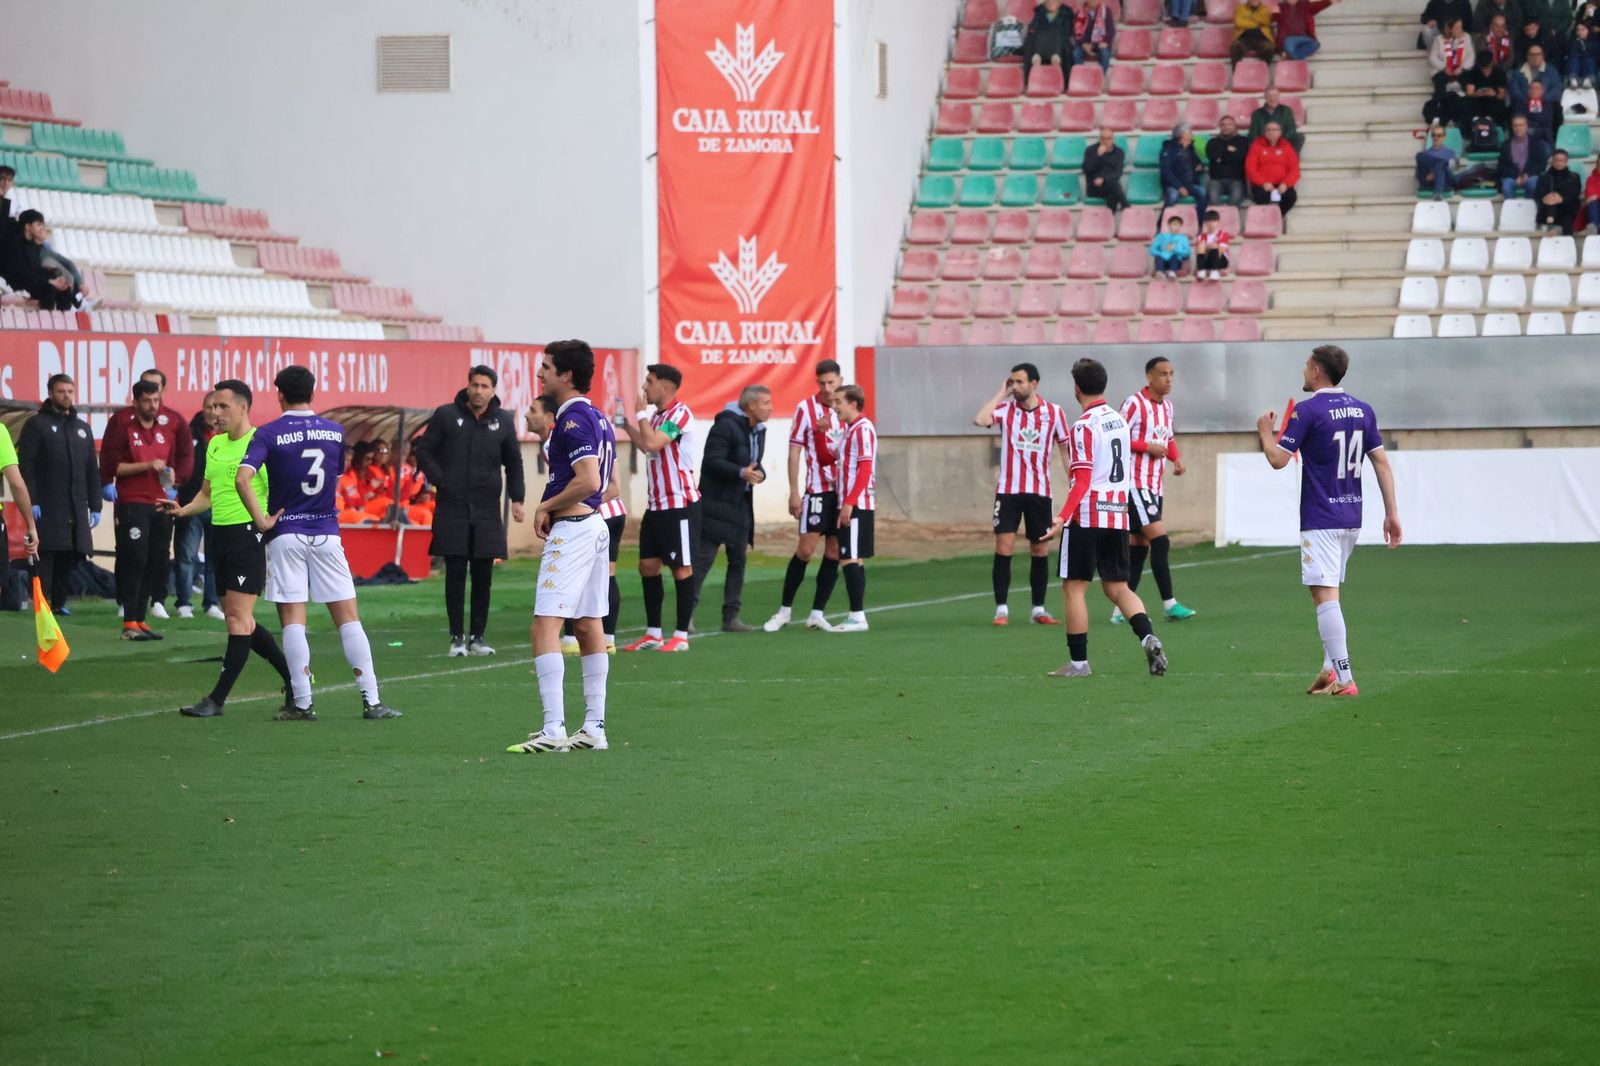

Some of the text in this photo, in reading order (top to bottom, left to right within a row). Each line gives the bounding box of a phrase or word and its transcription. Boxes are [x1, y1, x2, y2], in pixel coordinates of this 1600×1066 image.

[672, 108, 820, 134] CAJA RURAL
[698, 138, 794, 153] DE ZAMORA
[674, 320, 822, 345] CAJA RURAL
[701, 350, 797, 364] DE ZAMORA
[338, 352, 388, 393] STAND
[276, 429, 342, 446] AGUS MORENO
[1109, 438, 1124, 483] 8
[1333, 430, 1364, 479] 14
[301, 448, 325, 495] 3
[810, 496, 823, 514] 16
